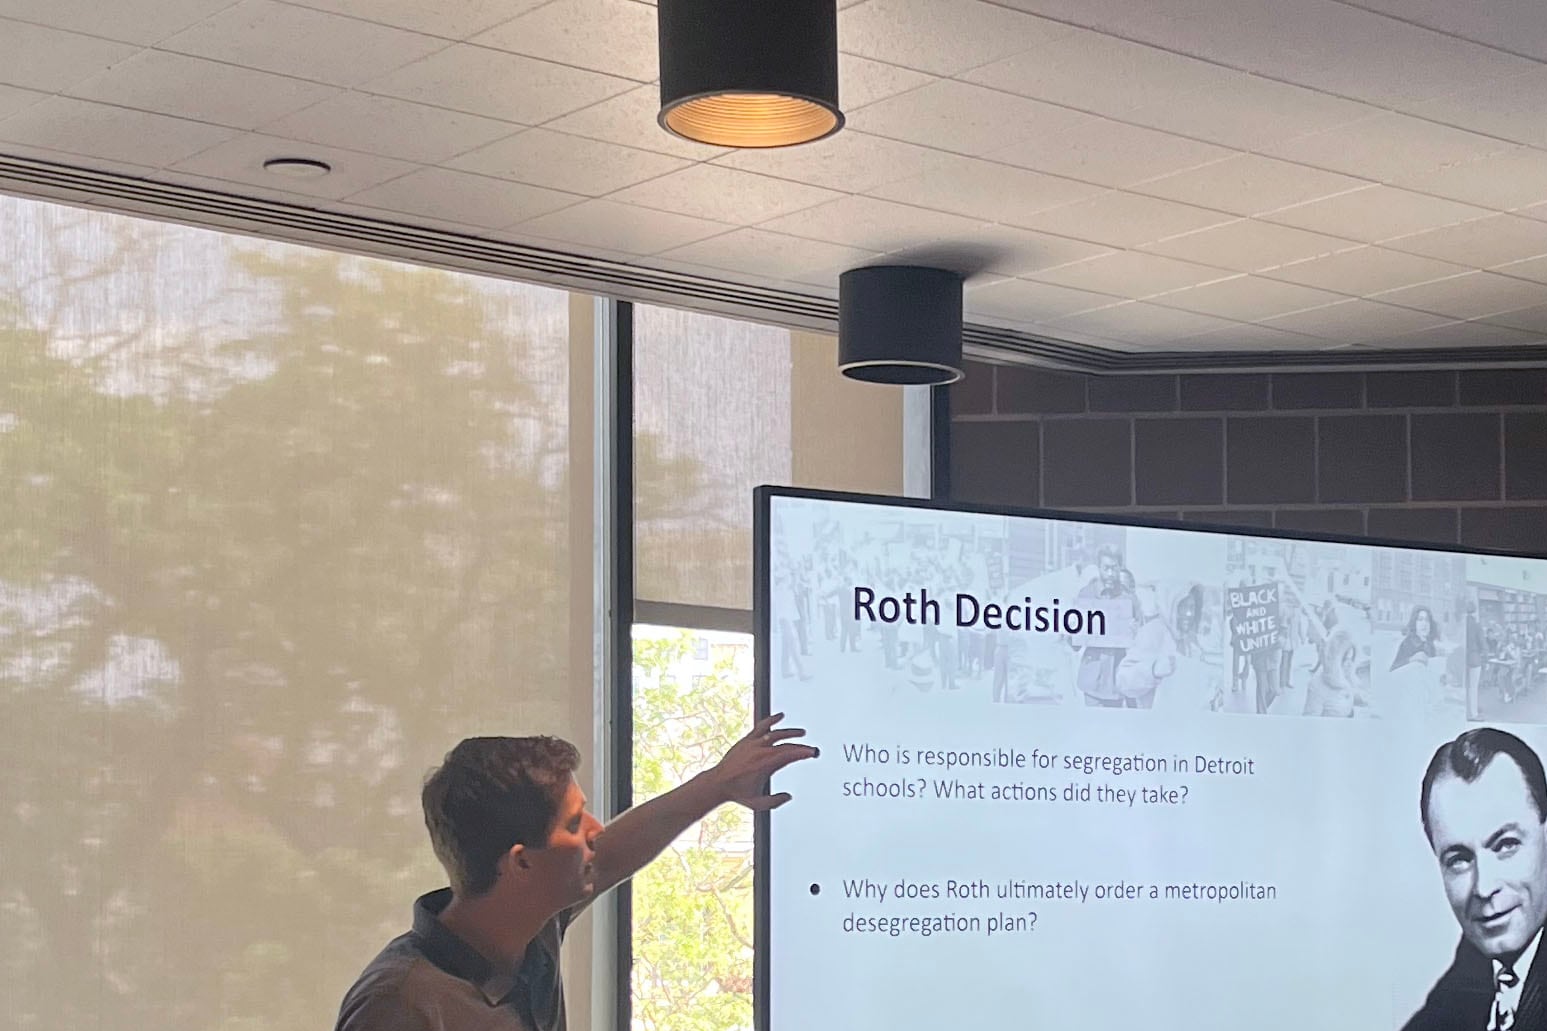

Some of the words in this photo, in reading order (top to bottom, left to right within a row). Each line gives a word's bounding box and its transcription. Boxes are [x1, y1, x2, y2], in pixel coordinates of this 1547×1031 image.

[854, 586, 941, 626] Roth
[955, 592, 1107, 636] Decision
[1230, 588, 1277, 608] BLACK
[1235, 615, 1276, 635] WHITE
[1246, 606, 1266, 618] AND
[1239, 630, 1279, 652] UNITE
[842, 743, 890, 765] Who
[896, 745, 911, 765] is
[917, 747, 1026, 771] responsible
[1031, 748, 1058, 769] for
[1063, 752, 1168, 776] segregation
[1173, 754, 1189, 773] in
[1195, 755, 1255, 776] Detroit
[842, 777, 927, 798] schools?
[933, 779, 985, 800] What
[991, 781, 1057, 801] actions
[1063, 783, 1091, 802] did
[1096, 783, 1137, 807] they
[1141, 785, 1189, 805] take?
[842, 879, 888, 904] Why
[894, 878, 940, 899] does
[946, 879, 991, 899] Roth
[997, 879, 1090, 904] ultimately
[1095, 879, 1144, 900] order
[1149, 884, 1159, 899] a
[1165, 880, 1277, 904] metropolitan
[842, 912, 981, 937] desegregation
[987, 911, 1038, 937] plan?
